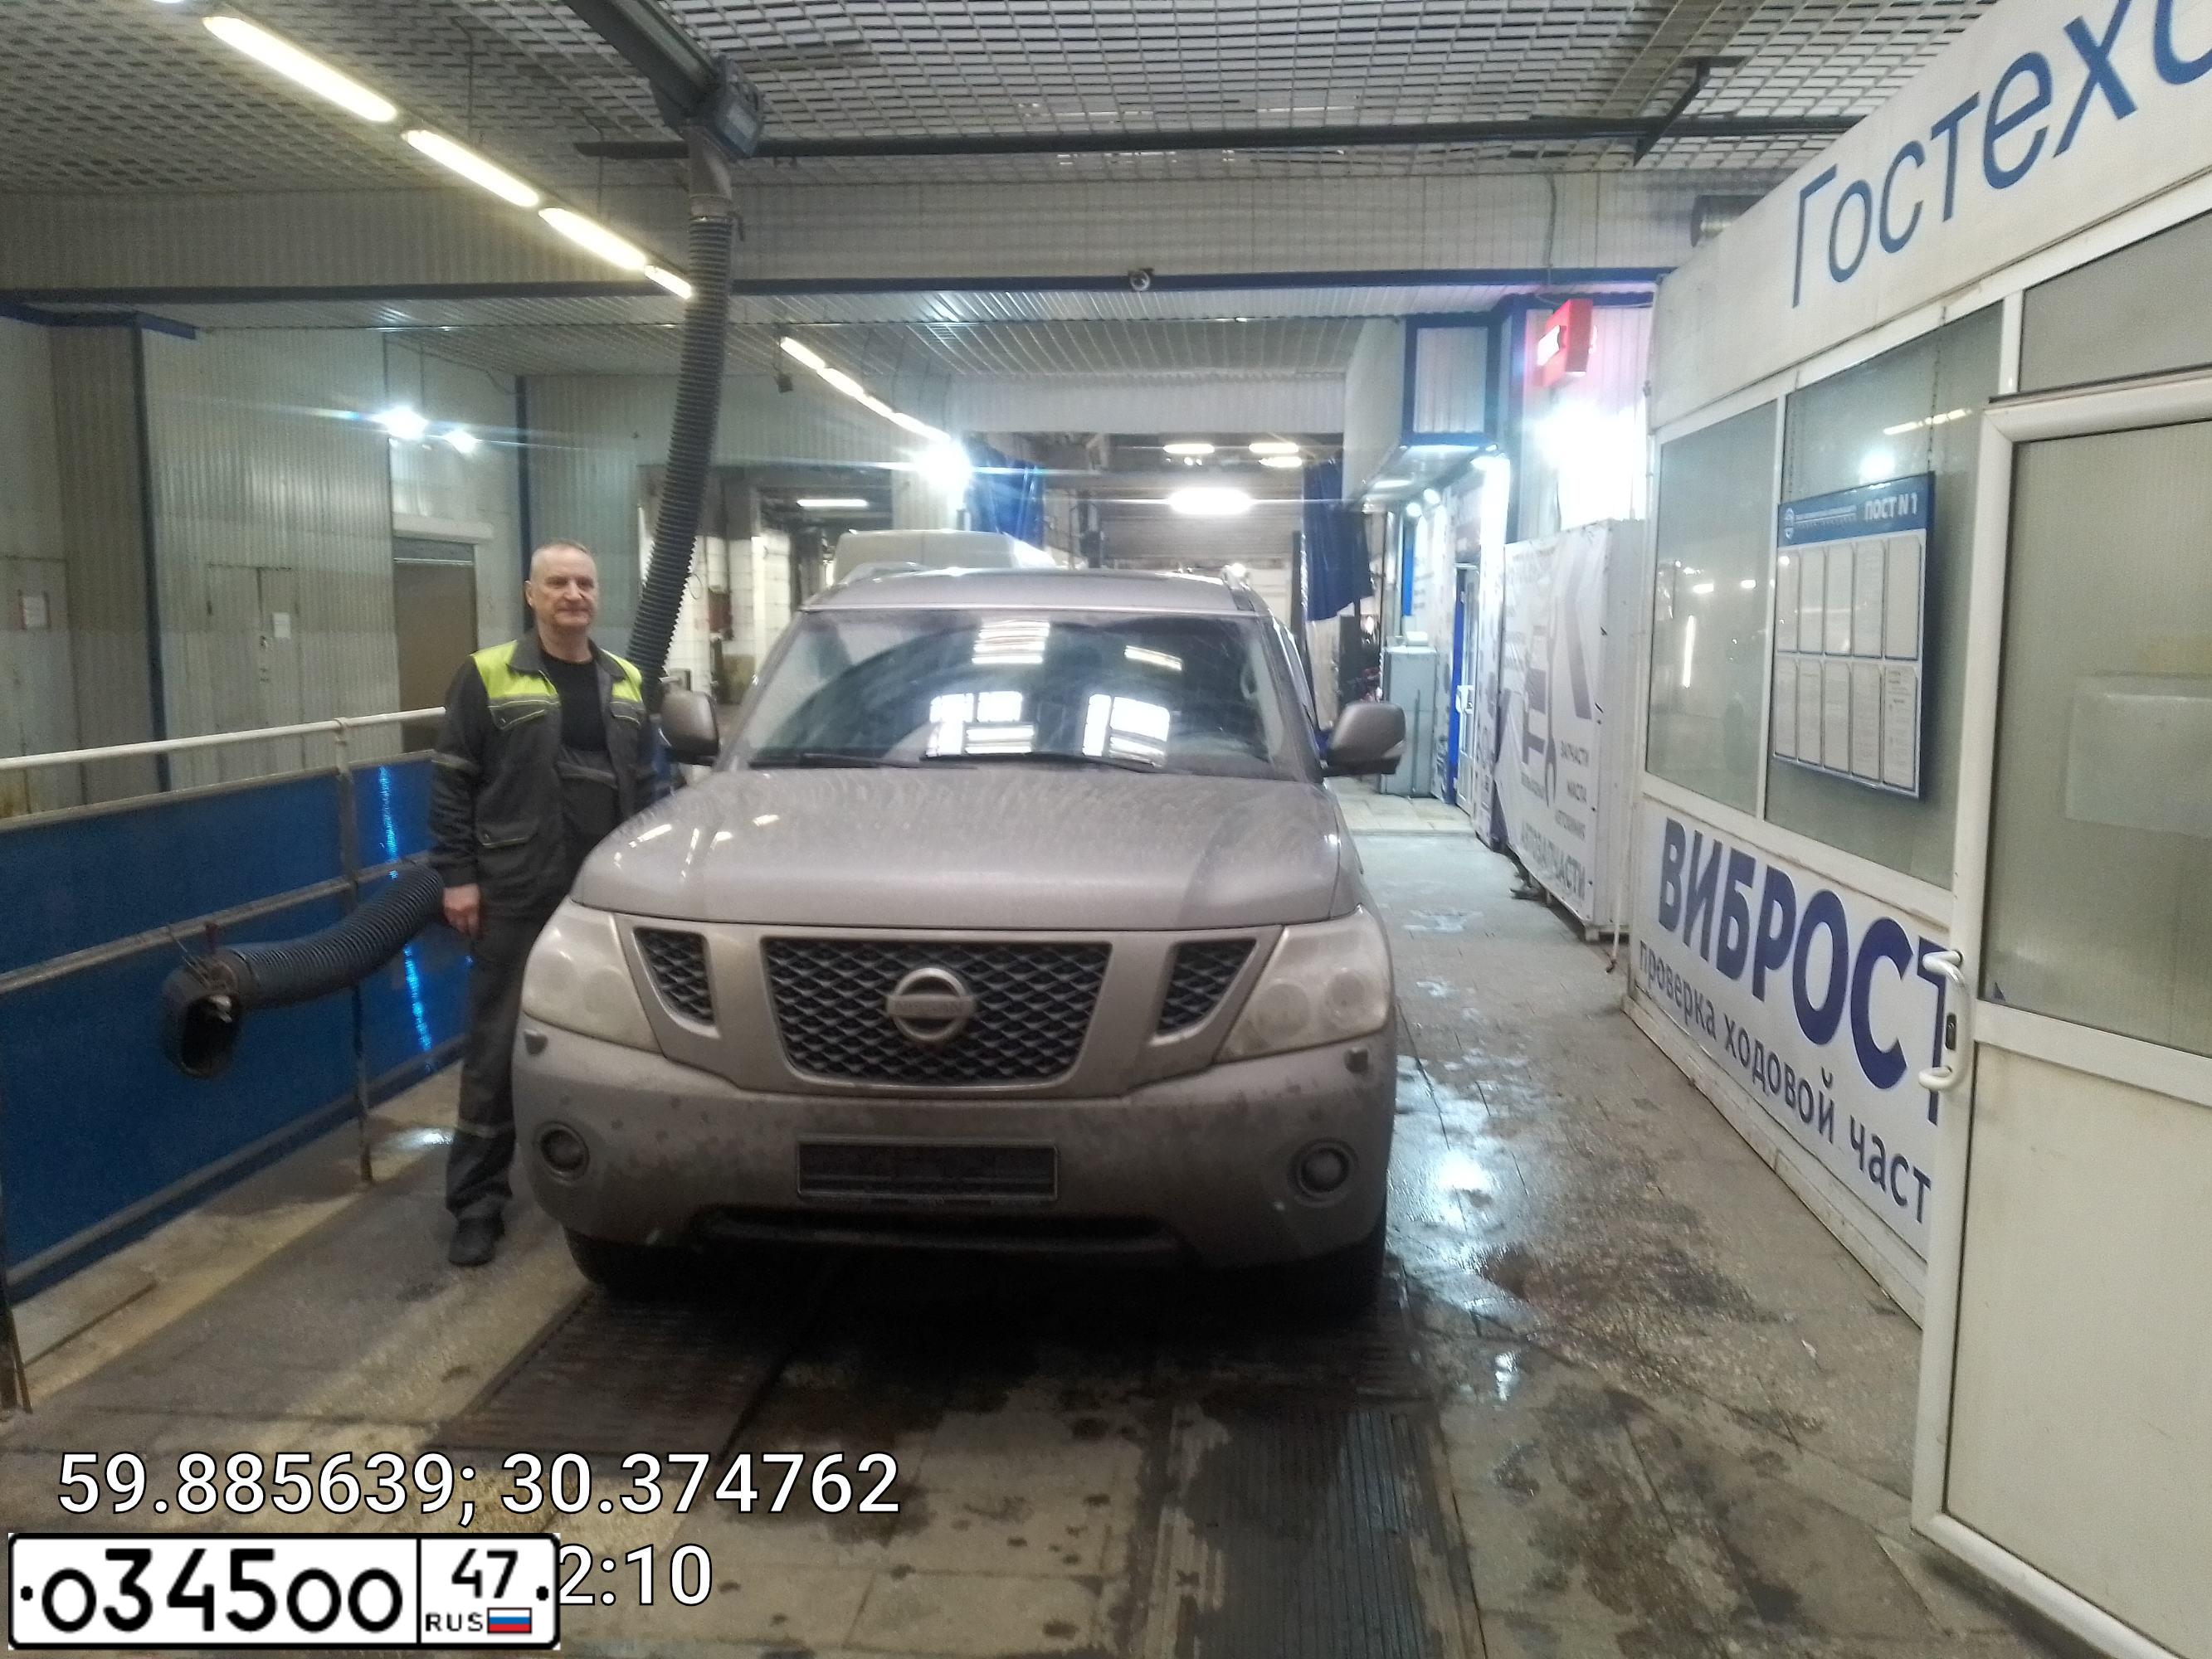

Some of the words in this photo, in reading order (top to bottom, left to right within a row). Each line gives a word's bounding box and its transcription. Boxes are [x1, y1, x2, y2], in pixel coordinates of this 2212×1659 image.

[1864, 496, 1898, 521] ПОСТ
[1910, 492, 1918, 515] 1
[1640, 939, 1717, 1039] проверка
[1724, 1012, 1834, 1145] ходовой
